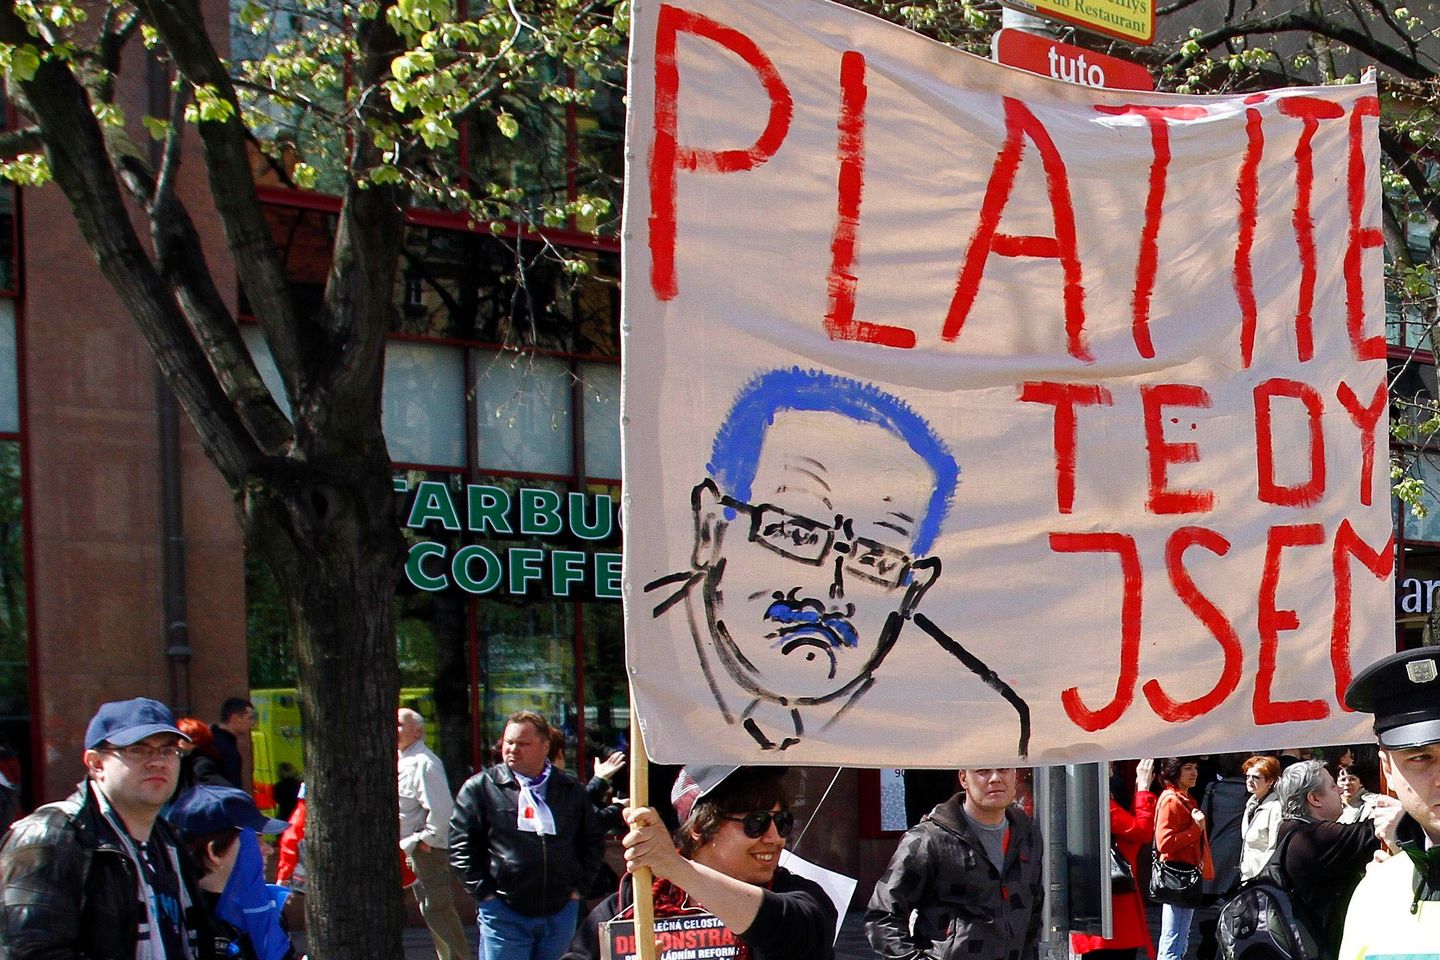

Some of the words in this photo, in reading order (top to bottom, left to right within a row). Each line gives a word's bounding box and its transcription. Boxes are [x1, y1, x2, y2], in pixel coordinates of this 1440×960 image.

[1048, 45, 1105, 88] tuto
[393, 479, 622, 540] ARBU
[698, 946, 739, 960] REFORM
